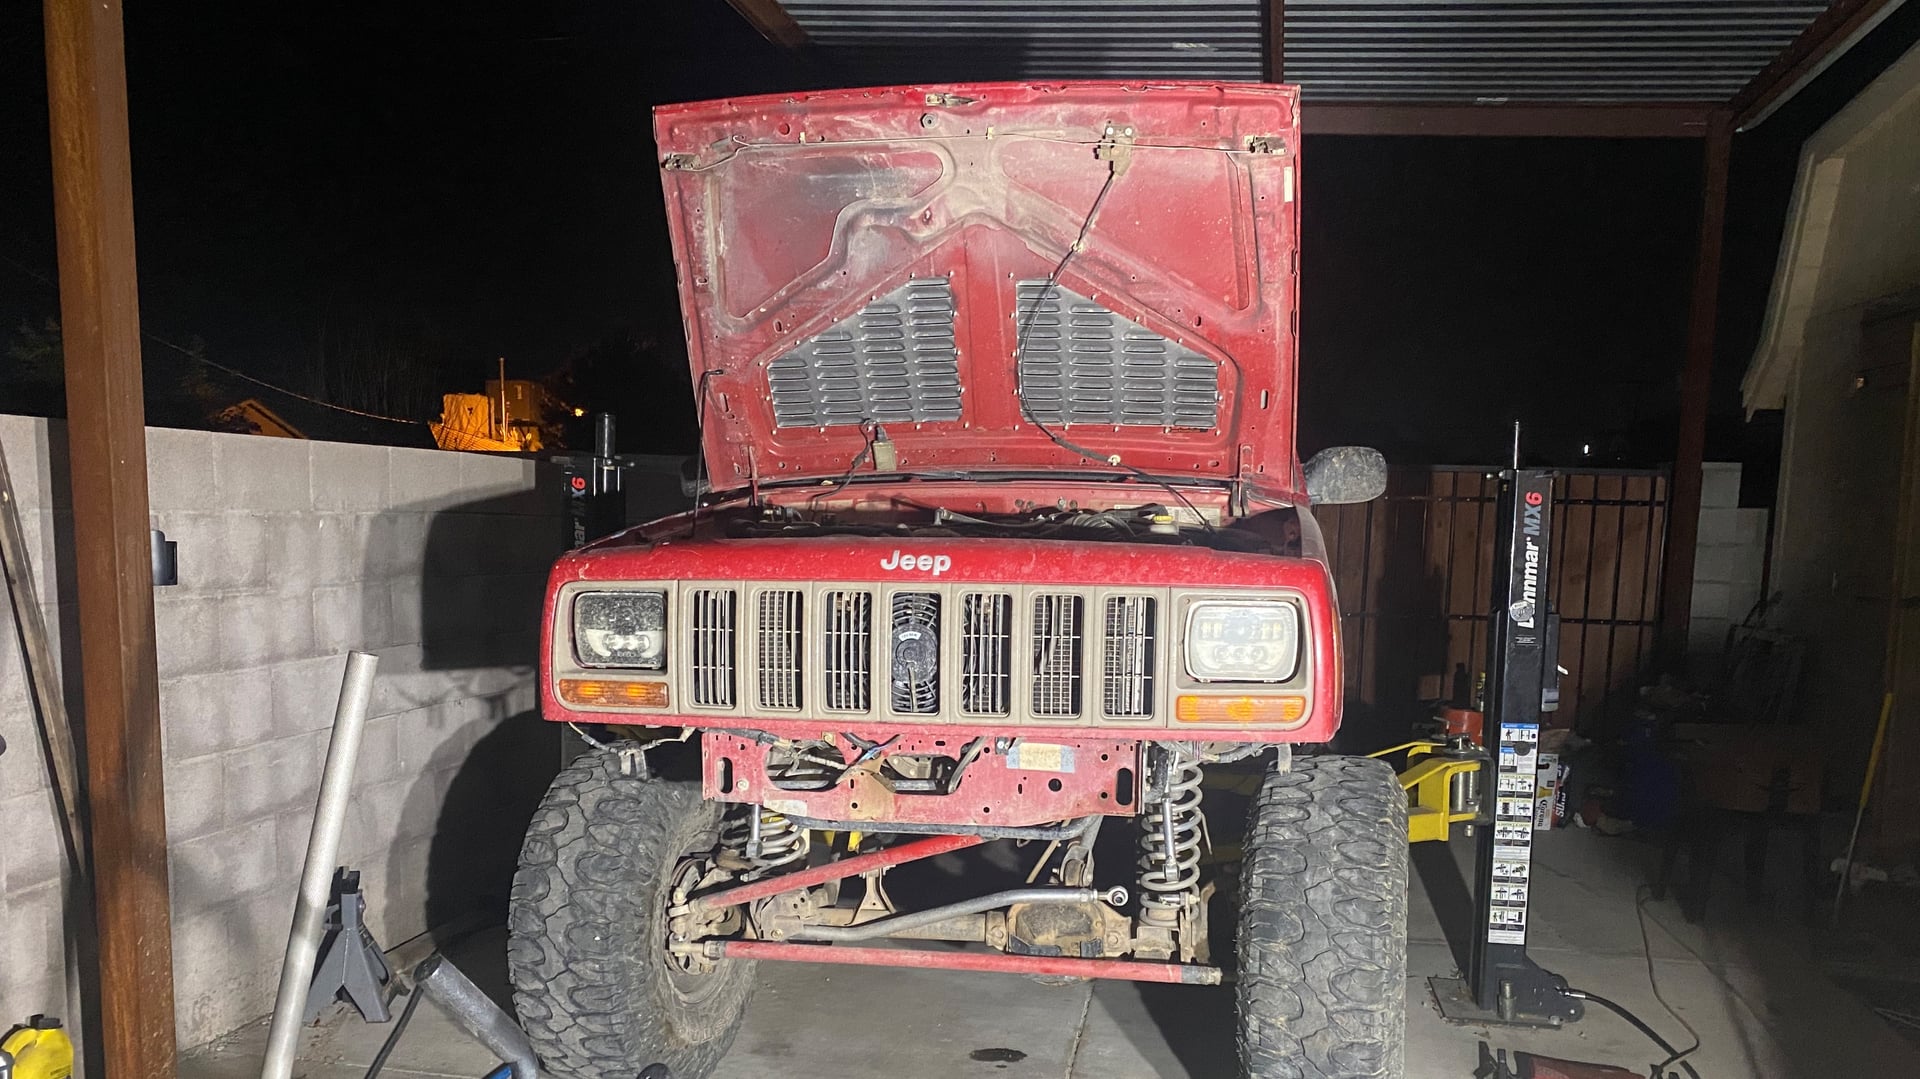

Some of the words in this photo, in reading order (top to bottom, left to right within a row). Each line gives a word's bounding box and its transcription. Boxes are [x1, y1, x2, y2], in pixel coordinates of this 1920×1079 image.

[1523, 491, 1543, 536] MX6
[880, 549, 951, 576] Jeep
[1537, 799, 1549, 827] Corona
